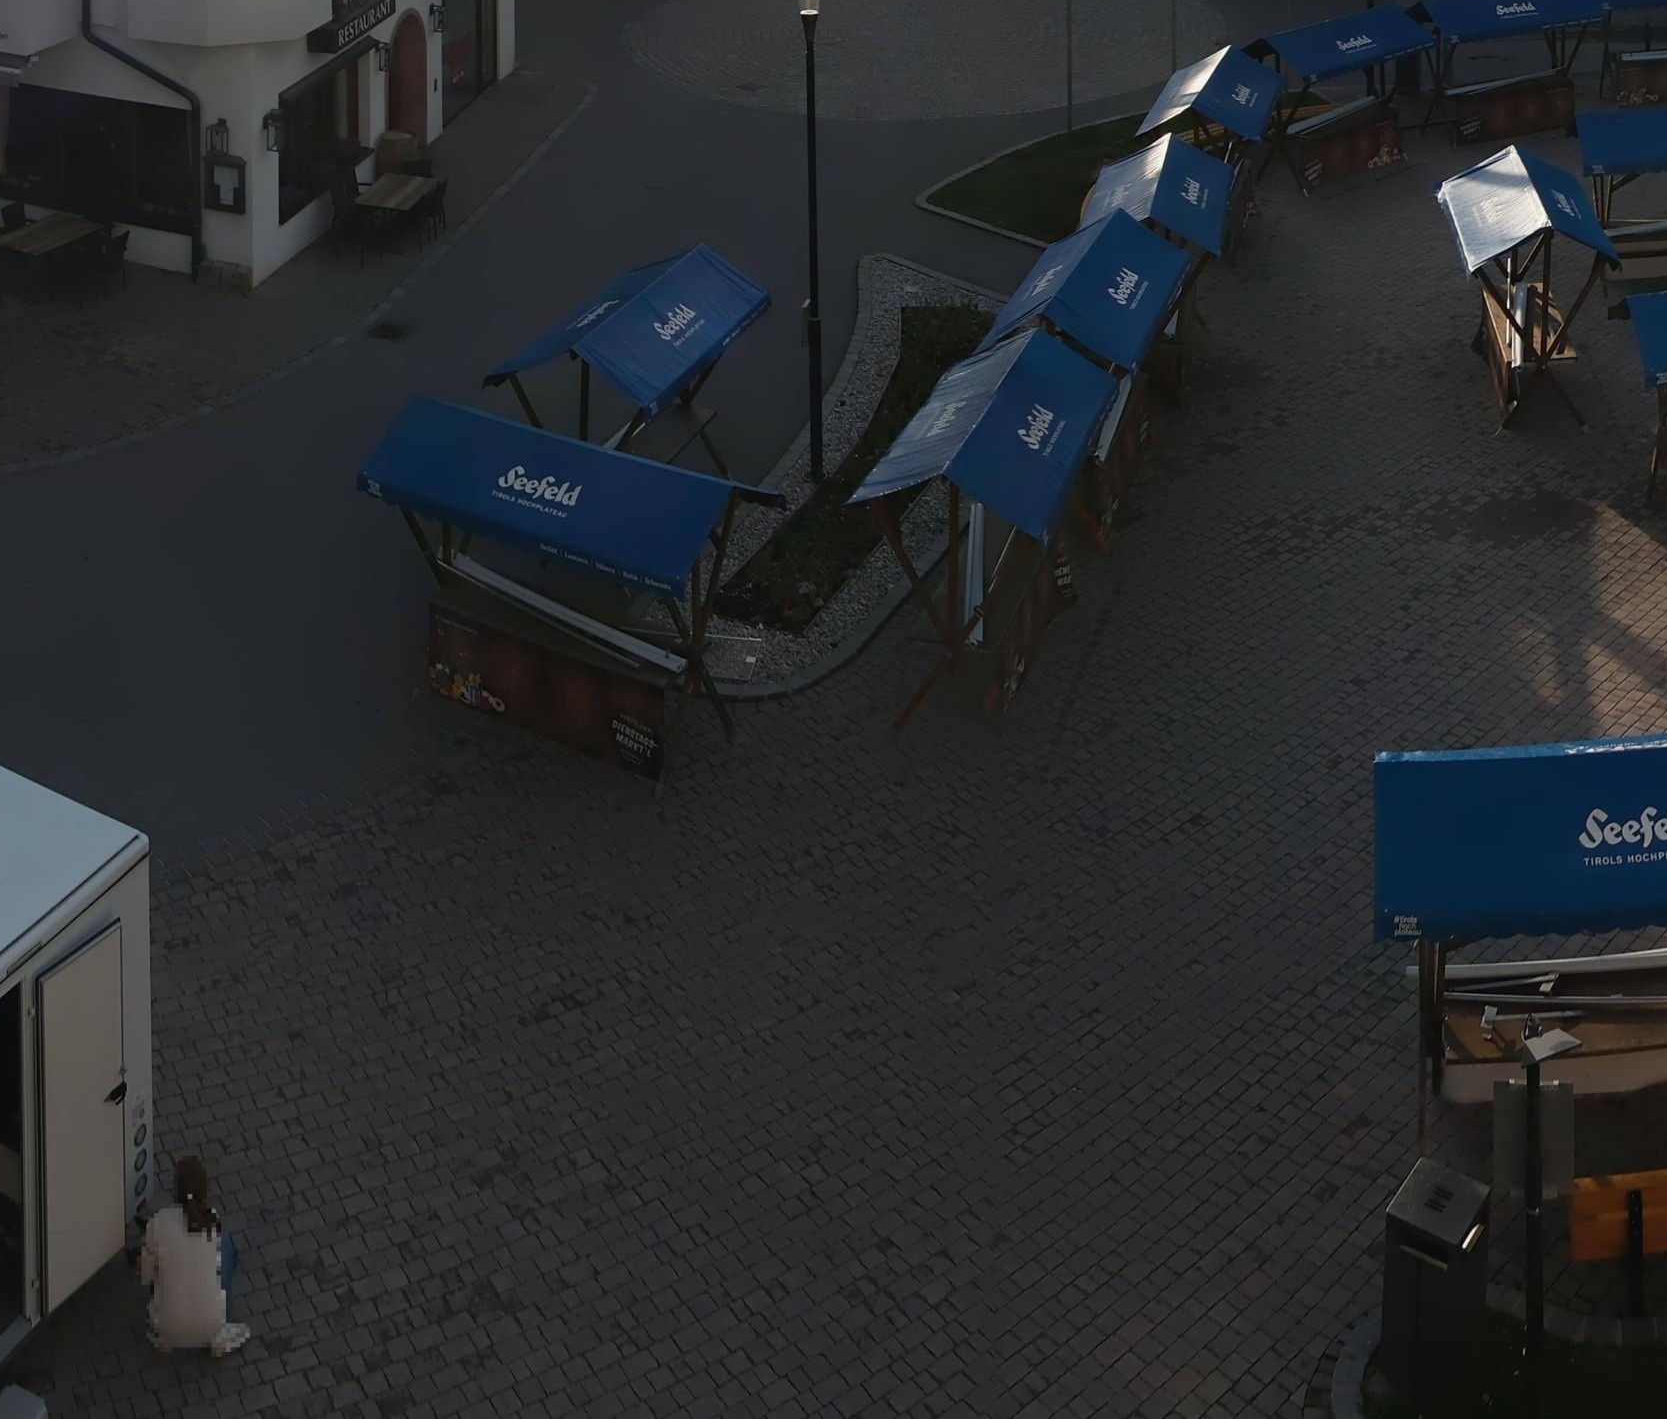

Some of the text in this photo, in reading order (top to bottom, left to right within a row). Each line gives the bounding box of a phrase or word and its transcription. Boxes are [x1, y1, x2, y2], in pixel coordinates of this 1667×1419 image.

[1496, 2, 1536, 16] Seefeld
[653, 303, 697, 342] Seefeld
[1017, 403, 1055, 450] Seefeld
[498, 465, 582, 507] Seefeld
[1583, 855, 1623, 867] TIROLS
